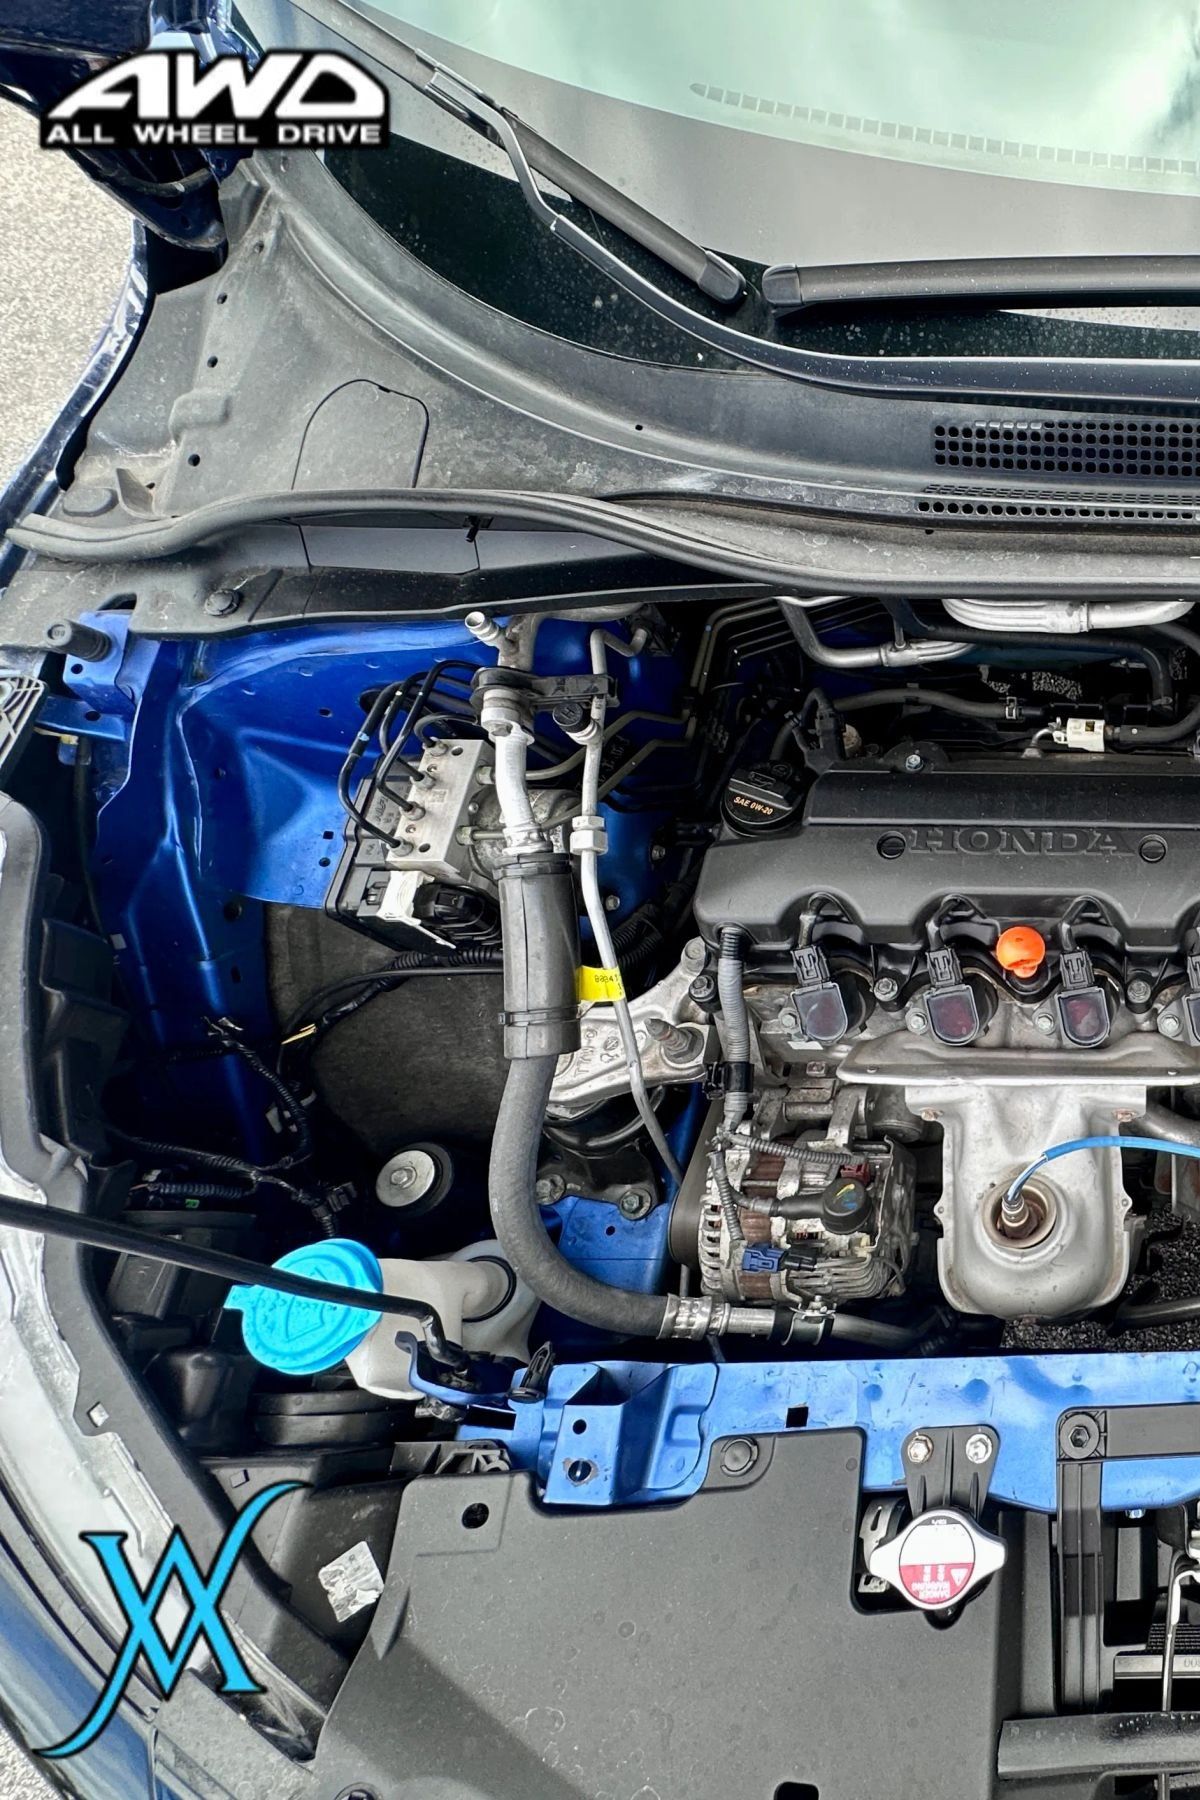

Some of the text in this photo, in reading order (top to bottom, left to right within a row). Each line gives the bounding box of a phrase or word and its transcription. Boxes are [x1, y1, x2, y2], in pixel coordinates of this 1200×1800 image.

[734, 797, 773, 815] SAE 0W-20
[908, 827, 1136, 855] HONDA
